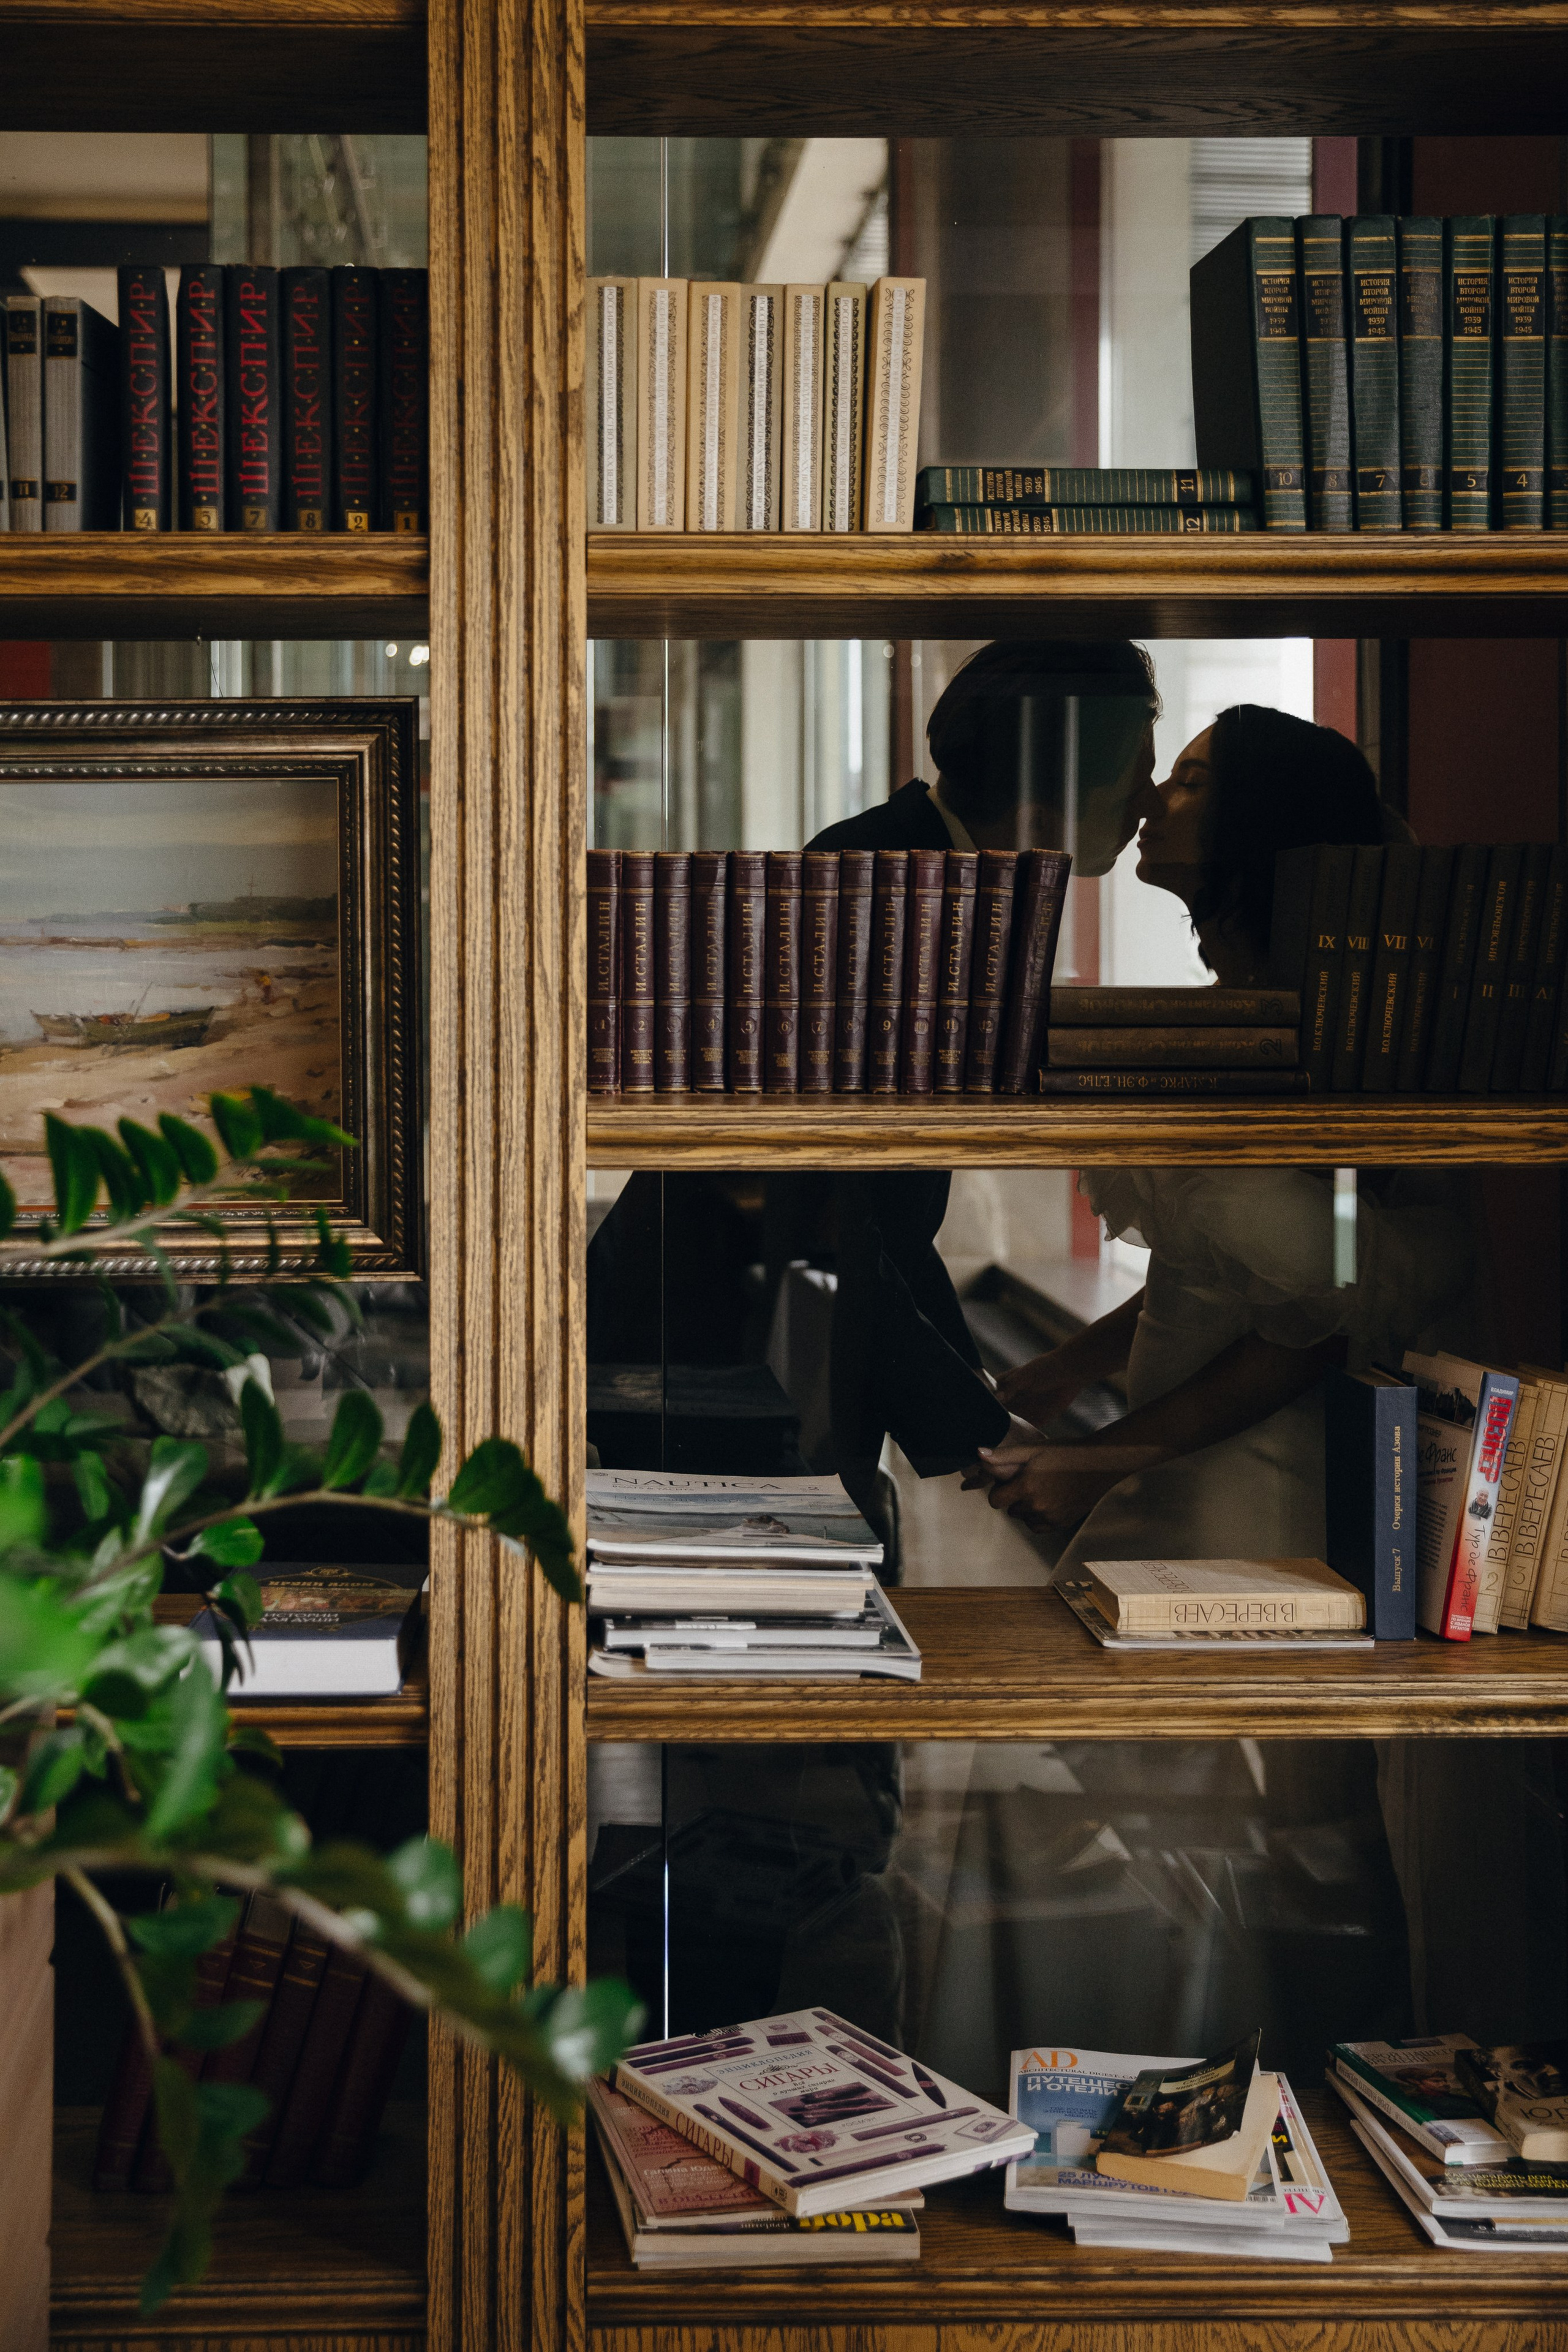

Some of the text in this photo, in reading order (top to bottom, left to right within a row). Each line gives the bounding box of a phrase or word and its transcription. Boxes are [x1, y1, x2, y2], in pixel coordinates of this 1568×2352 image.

[129, 282, 159, 495] ШЕКСПИР
[189, 281, 220, 494] ШЕКСПИР
[238, 282, 270, 495] ШЕКСПИР
[292, 286, 322, 498] ШЕКСПИР
[340, 286, 369, 496] ШЕКСПИР
[1005, 470, 1013, 502] МИРОВОЙ
[1181, 478, 1194, 492] 11
[1278, 472, 1292, 486] 10
[1329, 474, 1337, 488] 8
[1375, 474, 1385, 488] 7
[1467, 474, 1476, 488] 5
[1516, 473, 1528, 487] 4
[138, 511, 153, 527] 4
[199, 511, 212, 527] 5
[250, 511, 260, 526] 7
[306, 513, 316, 528] 8
[354, 515, 363, 529] 2
[403, 516, 411, 529] 1
[1042, 516, 1051, 532] 1945
[1318, 935, 1336, 949] IX
[1348, 936, 1370, 950] VIII
[1384, 934, 1408, 949] VII
[1417, 936, 1434, 949] VI
[1482, 983, 1493, 998] II
[638, 1020, 645, 1030] 2
[708, 1019, 715, 1029] 4
[745, 1021, 752, 1031] 5
[782, 1022, 788, 1031] 6
[816, 1022, 822, 1031] 7
[883, 1020, 891, 1030] 9
[946, 1020, 955, 1030] 11
[1491, 1387, 1513, 1395] ВЛАДИМИР
[1392, 1425, 1401, 1453] Азова
[1477, 1395, 1513, 1483] ПОЗНЕР
[1425, 1441, 1457, 1475] Франс
[614, 1477, 782, 1490] NAUTICA
[1393, 1457, 1401, 1495] истории
[1488, 1440, 1526, 1561] В.ВЕРЕСАЕВ
[1515, 1436, 1556, 1556] В.ВЕРЕСАЕВ
[1392, 1499, 1401, 1529] Очерки
[1392, 1556, 1401, 1592] Выпуск
[1458, 1525, 1485, 1611] Тур де Франс
[1513, 1566, 1525, 1585] 3
[1485, 1572, 1498, 1591] 2
[1174, 1603, 1294, 1623] В.ВЕРЕСАЕВ
[717, 2049, 812, 2075] ЭНЦИКЛОПЕДИЯ
[1021, 2051, 1078, 2070] AD
[739, 2063, 841, 2092] СИГАРЫ
[1027, 2076, 1130, 2090] ПУТЕШЕС
[1046, 2084, 1118, 2096] ОТЕЛИ
[621, 2078, 670, 2119] ЭНЦИКЛОПЕДИЯ
[676, 2112, 734, 2169] СИГАРЫ
[1058, 2177, 1160, 2193] МАРШРУТОВ
